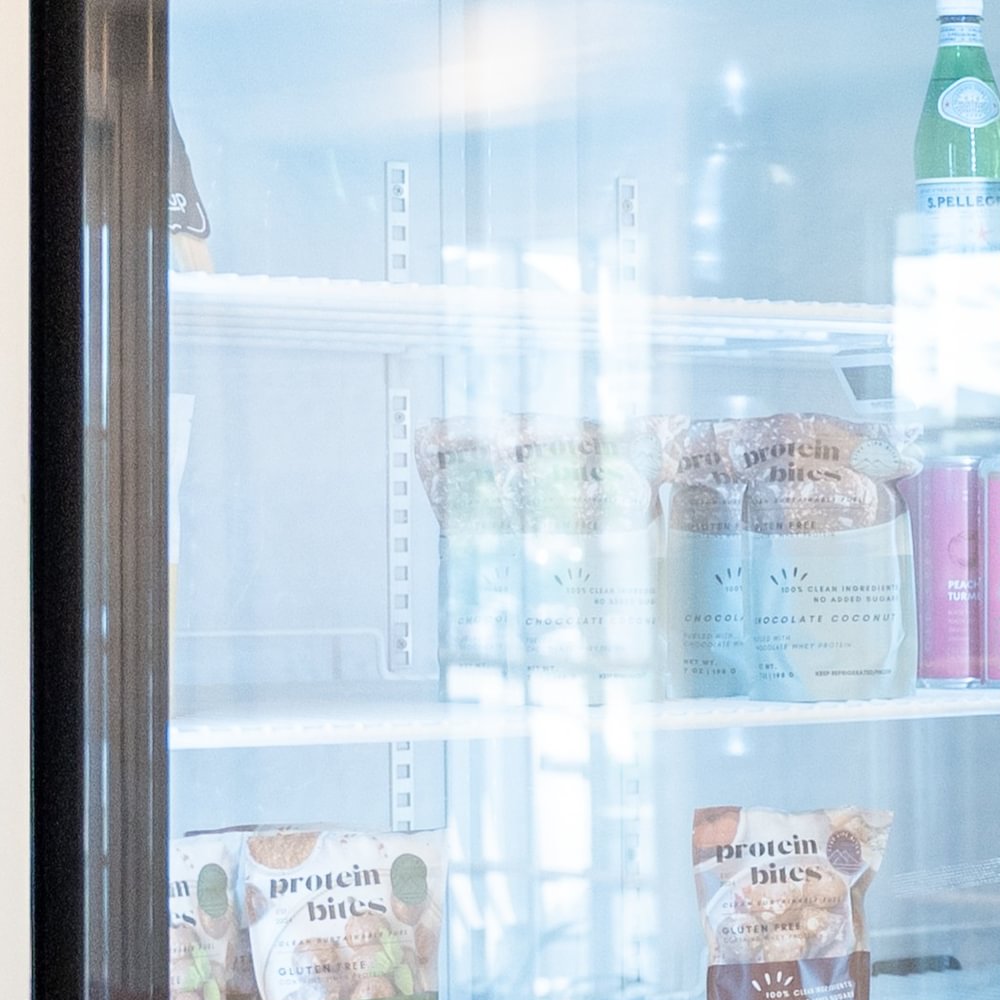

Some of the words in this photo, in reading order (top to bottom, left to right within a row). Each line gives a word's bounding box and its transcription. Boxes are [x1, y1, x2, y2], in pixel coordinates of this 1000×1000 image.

[743, 438, 841, 468] protein
[768, 461, 842, 483] bites
[807, 585, 838, 593] CLEAN
[716, 833, 819, 864] protein
[269, 863, 382, 898] protein
[750, 862, 823, 886] bites
[308, 896, 388, 923] bites
[721, 924, 769, 936] GLUTEN
[278, 963, 330, 977] GLUTEN
[766, 990, 790, 999] 100%
